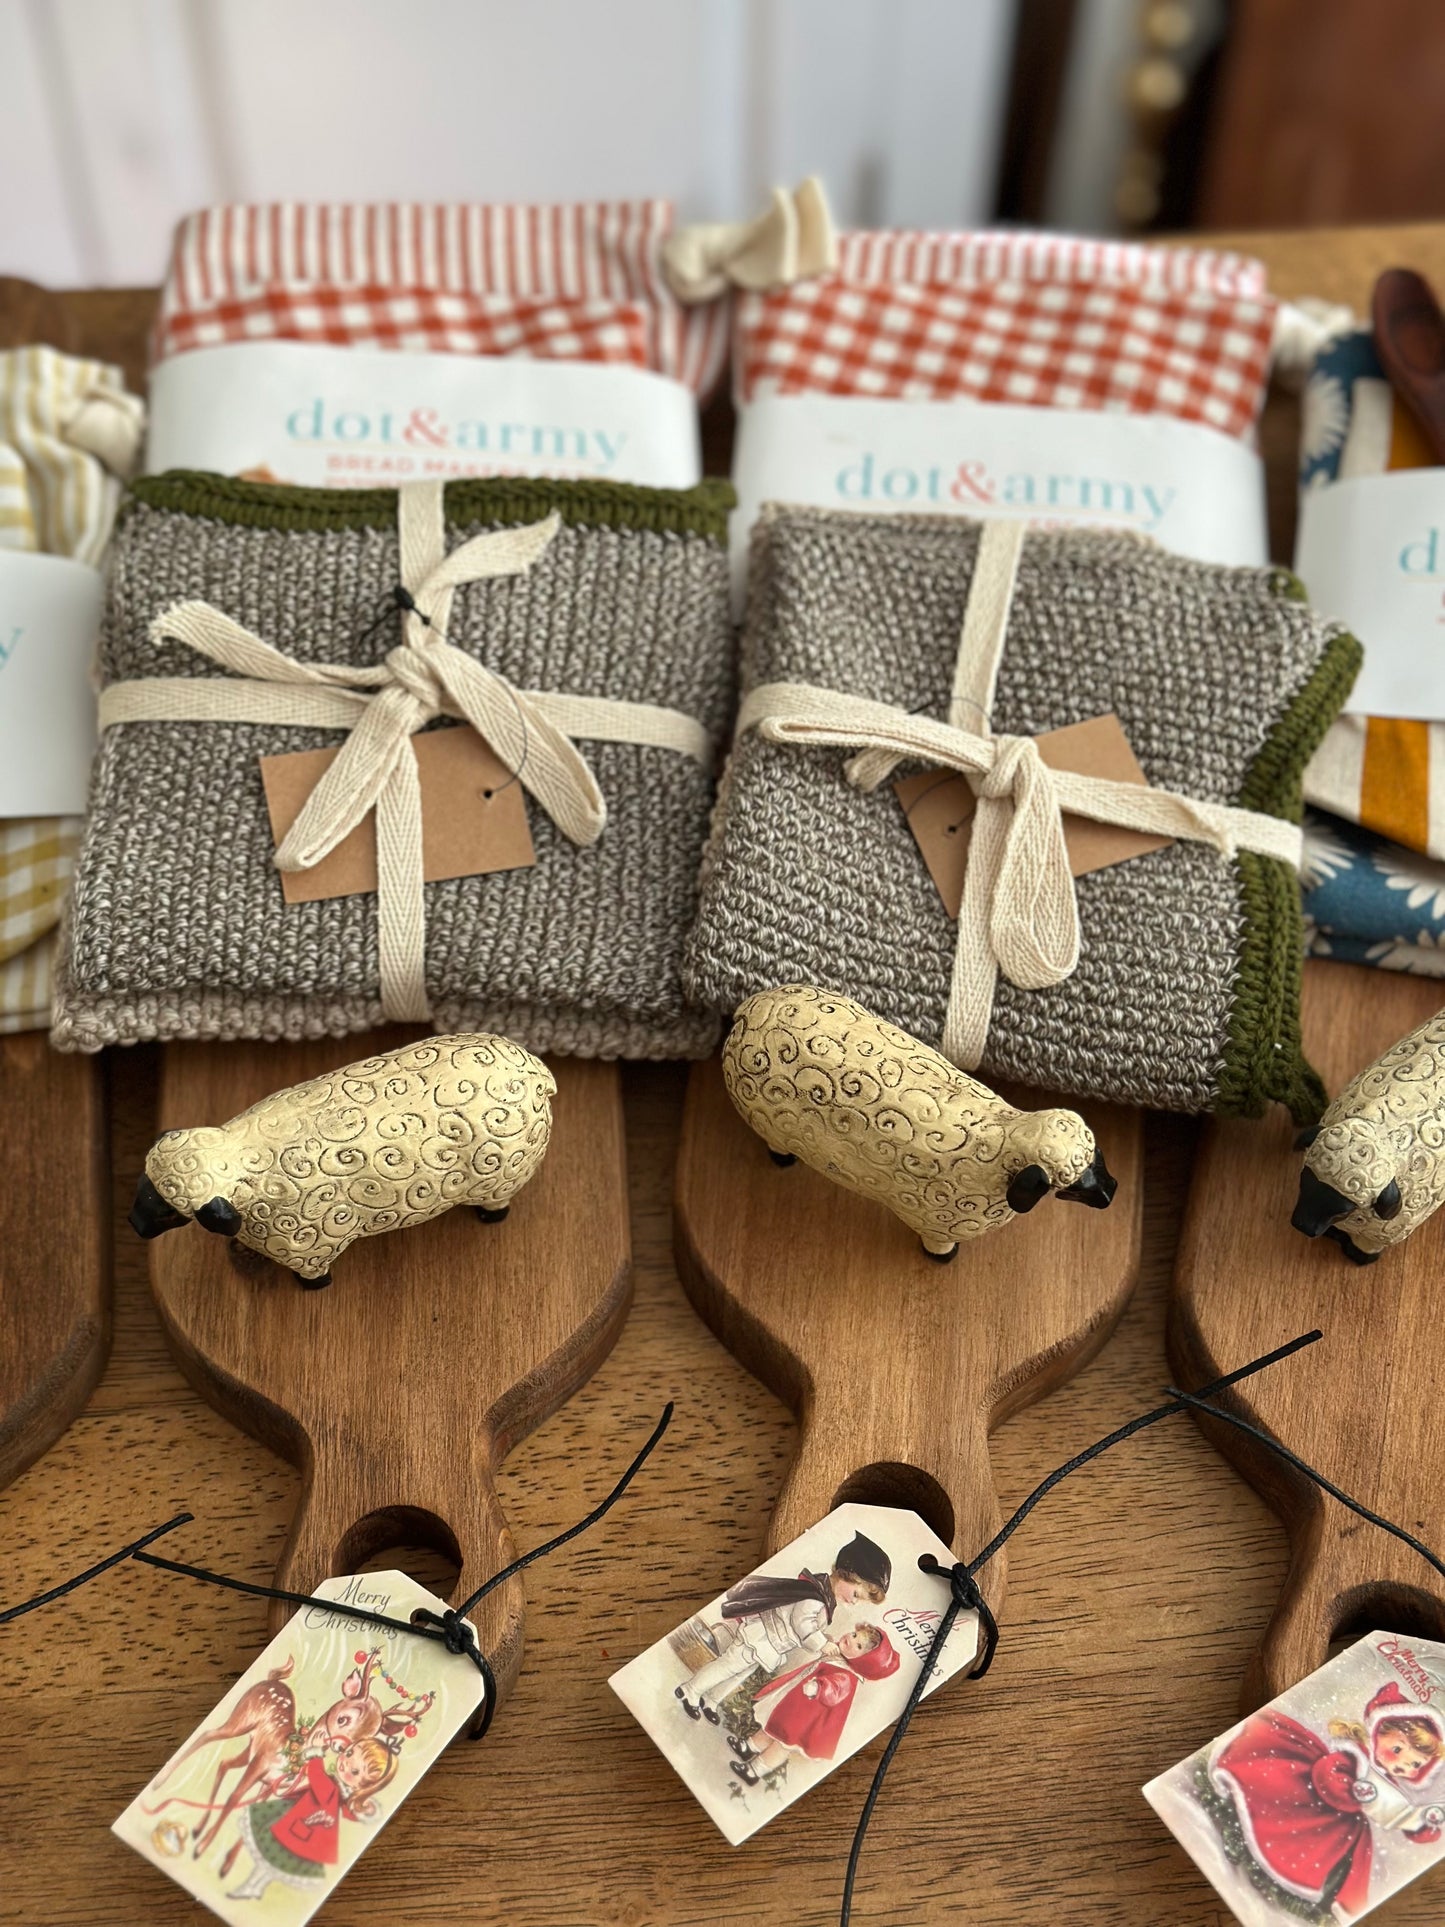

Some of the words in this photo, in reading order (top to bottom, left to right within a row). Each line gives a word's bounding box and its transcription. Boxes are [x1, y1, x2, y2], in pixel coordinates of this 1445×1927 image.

[286, 397, 628, 471] dot&army
[834, 452, 1177, 529] dot&army
[333, 1576, 392, 1614] Merry
[1376, 1635, 1440, 1704] Christmas
[1399, 1648, 1430, 1690] Merry
